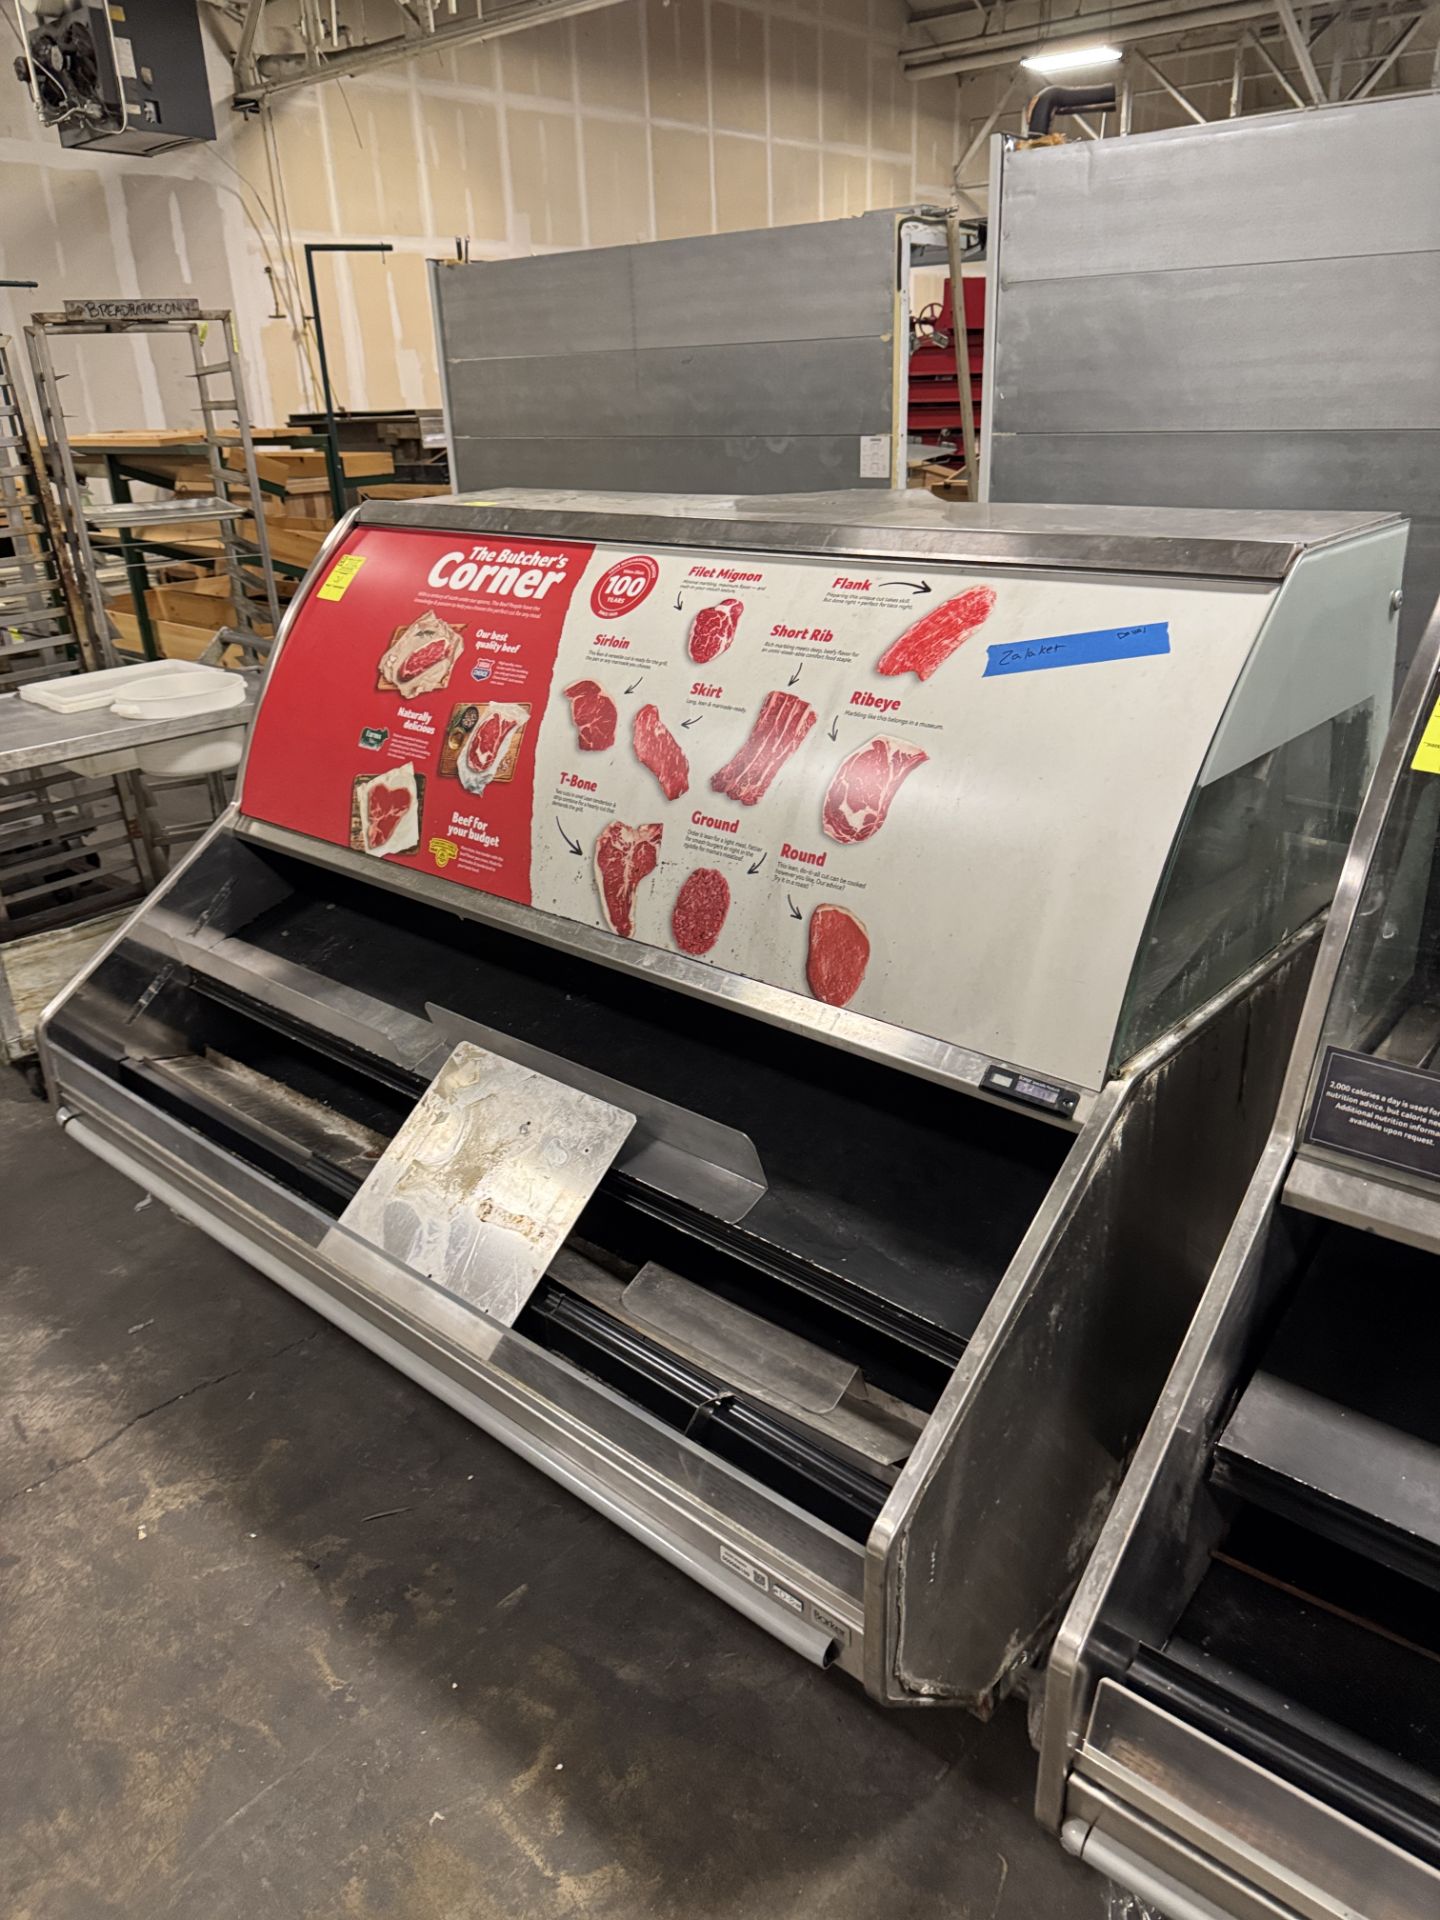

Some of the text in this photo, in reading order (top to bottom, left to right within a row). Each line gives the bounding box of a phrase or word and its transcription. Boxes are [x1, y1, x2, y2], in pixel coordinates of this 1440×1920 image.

[468, 546, 569, 569] The Butcher's
[427, 551, 566, 600] Corner
[688, 566, 763, 583] Filet Mignon
[832, 577, 873, 591] Flank
[605, 575, 646, 597] 100
[475, 629, 509, 642] Our best
[593, 633, 631, 649] Sirloin
[770, 624, 834, 643] Short Rib
[475, 640, 521, 653] quality beef
[690, 682, 723, 699] Skirt
[849, 691, 901, 713] Ribeye
[397, 706, 433, 725] Naturally
[402, 719, 436, 735] delicious
[560, 771, 598, 792] T-Bone
[451, 811, 488, 831] Beef for
[691, 810, 740, 834] Ground
[446, 825, 500, 848] your budget
[780, 843, 827, 867] Round
[1325, 1090, 1359, 1104] nutrition
[1358, 1098, 1385, 1112] advice,
[1386, 1106, 1400, 1117] but
[1400, 1110, 1428, 1124] calorie
[1329, 1080, 1351, 1092] 2,000
[1351, 1087, 1380, 1100] calories
[1386, 1096, 1401, 1107] day
[1401, 1099, 1408, 1108] is
[1409, 1104, 1428, 1113] used
[1334, 1102, 1374, 1119] Additional
[1374, 1114, 1409, 1129] nutrition
[1348, 1116, 1435, 1146] available upon request.
